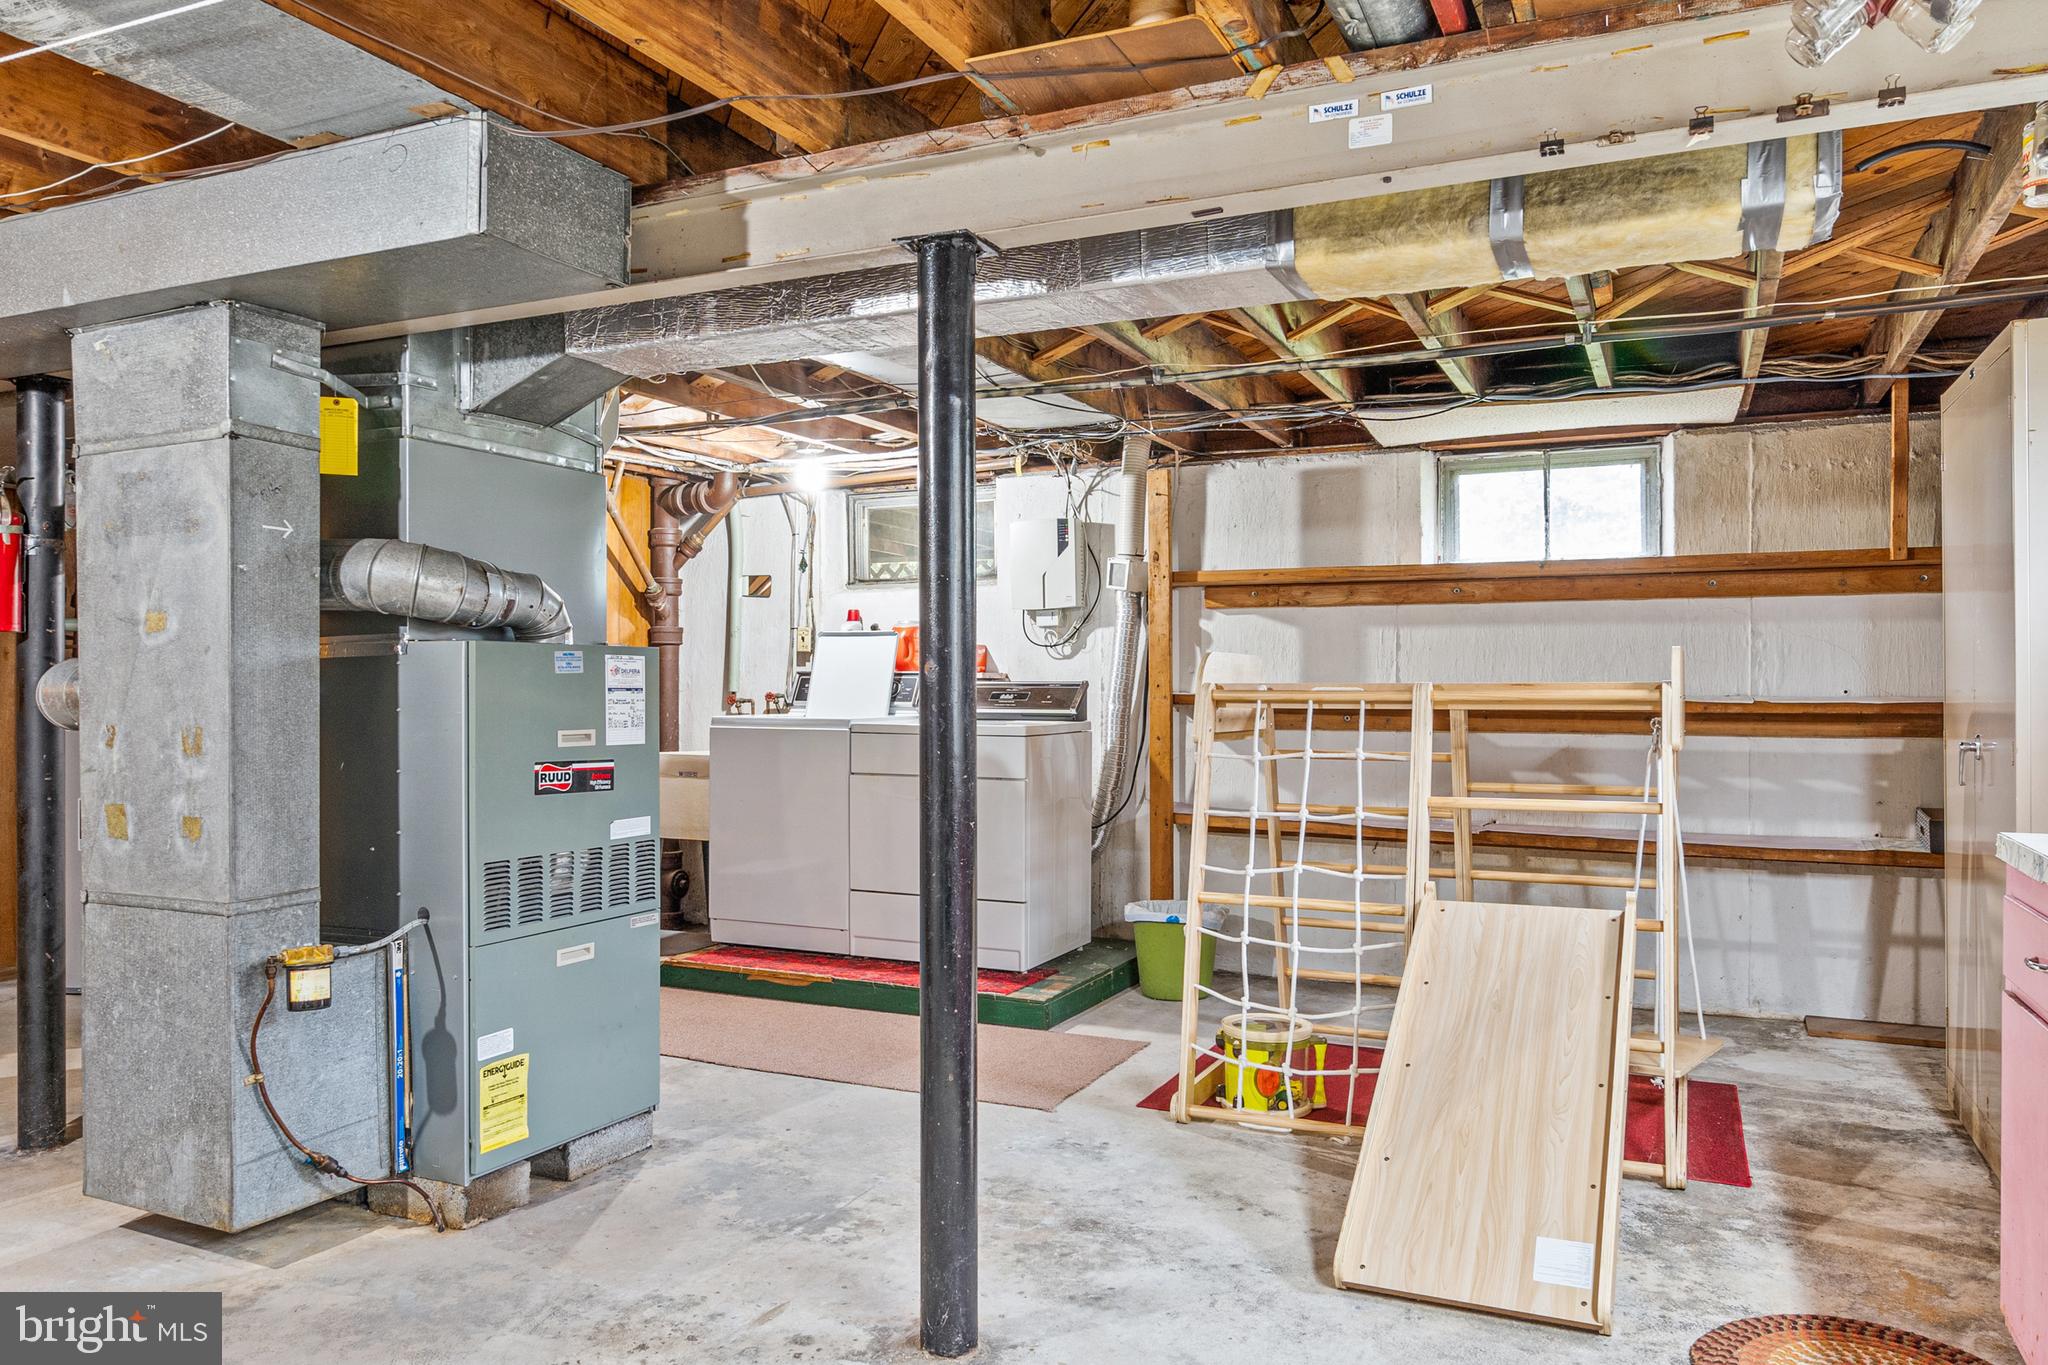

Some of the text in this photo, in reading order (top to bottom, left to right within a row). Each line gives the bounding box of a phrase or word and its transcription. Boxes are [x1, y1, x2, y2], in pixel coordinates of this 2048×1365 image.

[1396, 89, 1426, 100] SCHULZE
[1324, 103, 1353, 114] SCHULZE
[540, 772, 571, 783] RUUD
[396, 942, 402, 954] 3M
